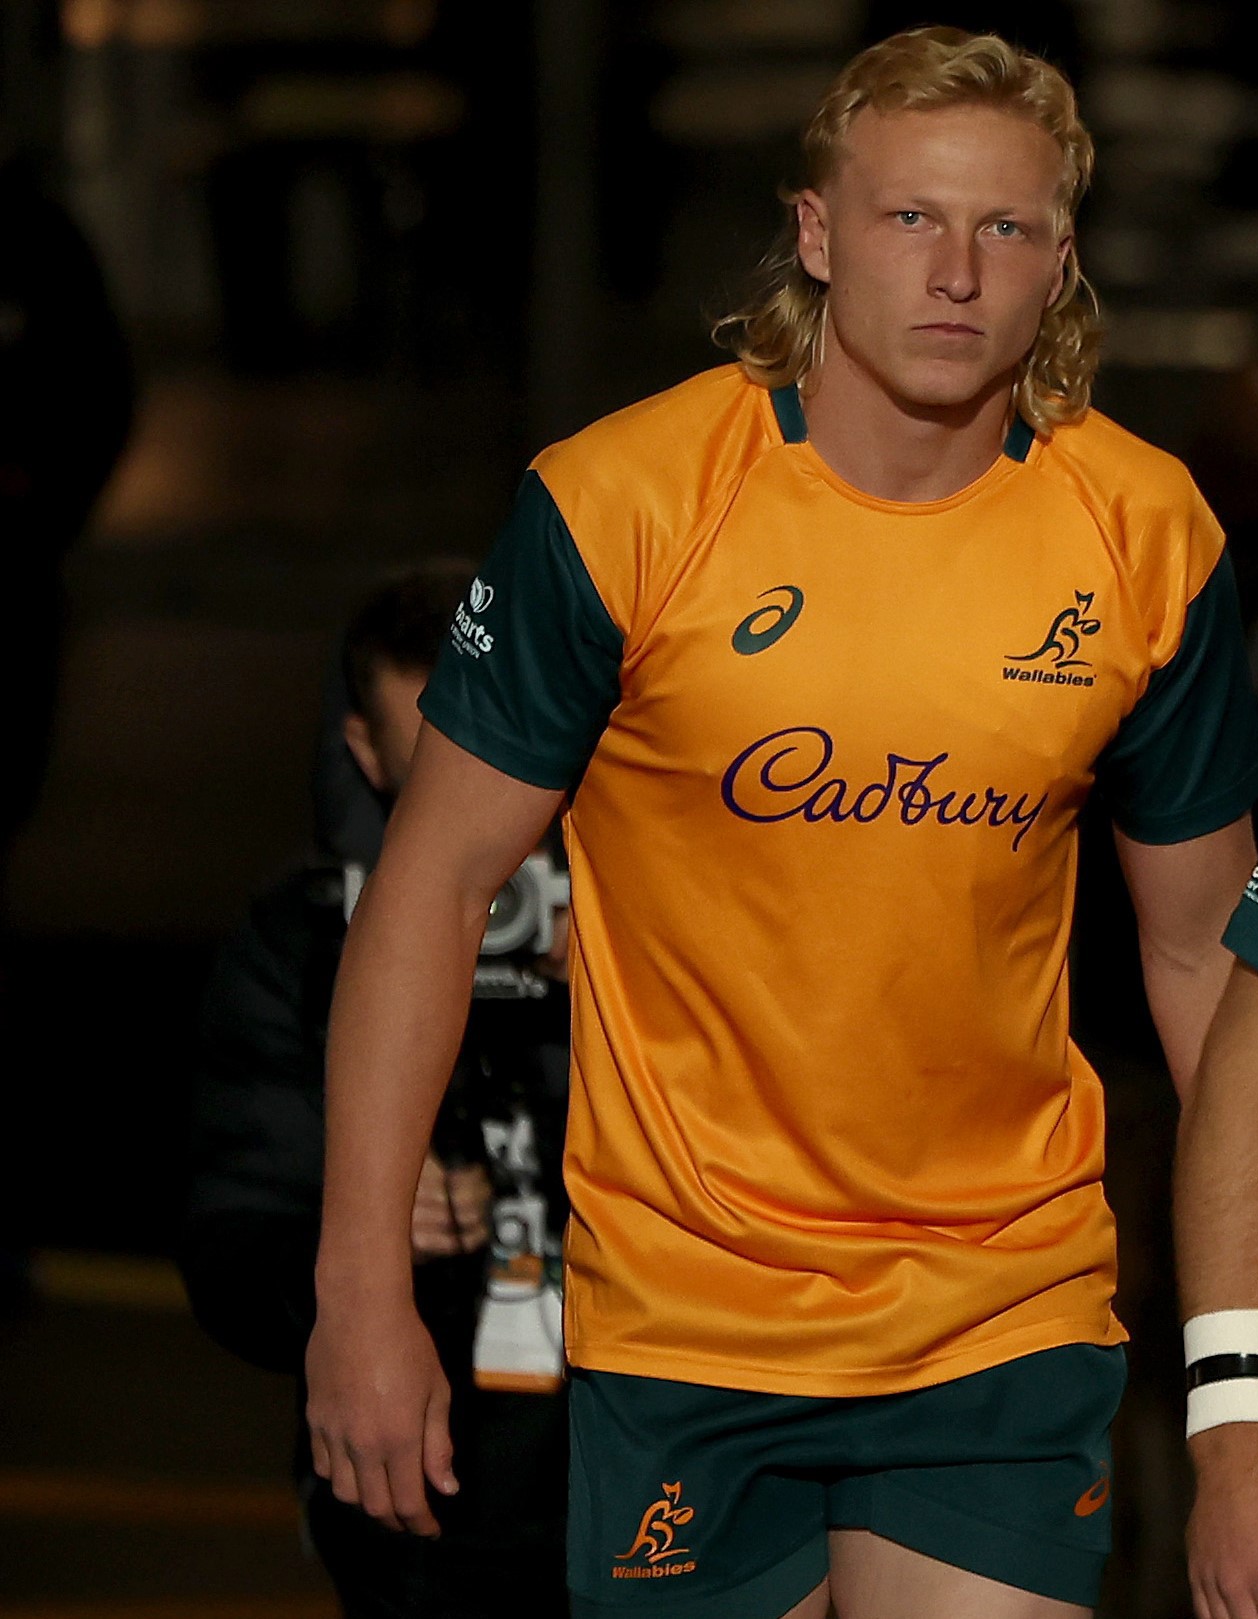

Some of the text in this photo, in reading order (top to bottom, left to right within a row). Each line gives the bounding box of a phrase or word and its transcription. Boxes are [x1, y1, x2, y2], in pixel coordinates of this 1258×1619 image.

[1002, 667, 1095, 687] Wallabies
[721, 726, 1048, 852] Cadbury
[612, 1560, 697, 1579] Wallabies
